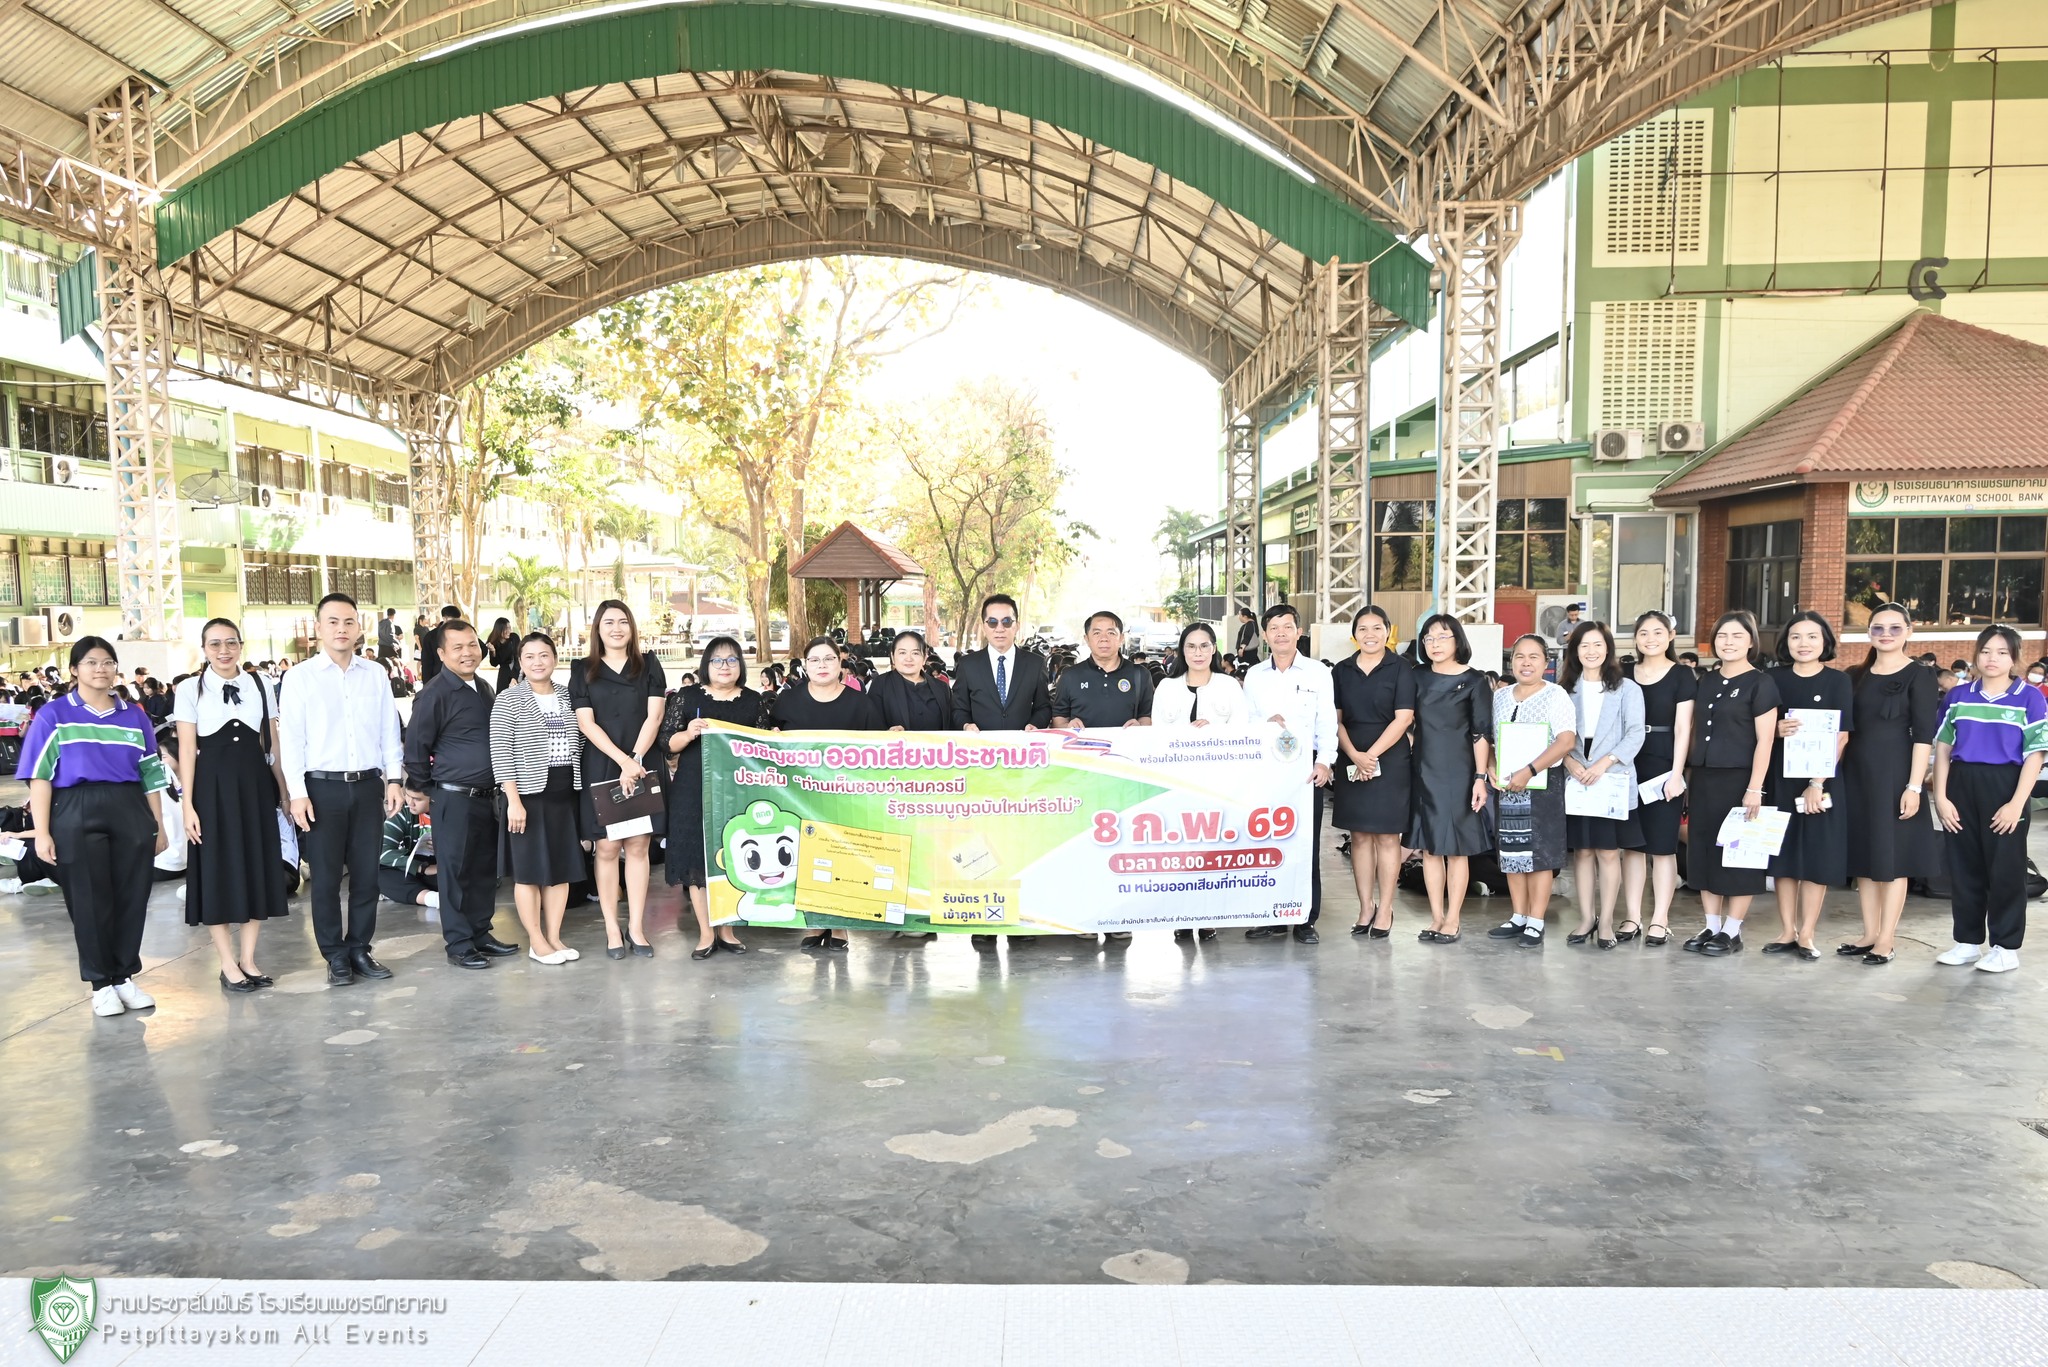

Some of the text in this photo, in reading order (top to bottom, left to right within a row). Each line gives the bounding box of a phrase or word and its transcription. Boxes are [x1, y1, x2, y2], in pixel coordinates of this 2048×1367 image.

[1893, 492, 2044, 504] PETPITTAYAKOM SCHOOL BANK
[1168, 736, 1261, 749] สร้างสรรค์ประเทศไทย
[731, 740, 1047, 767] ขอเชิญชวน ออกเสียงประชามติ
[1139, 750, 1263, 764] พร้อมใจไปออกเสียงประชามติ
[735, 767, 787, 785] ประเด็น
[1093, 806, 1296, 843] 8 ก.พ. 69
[1118, 857, 1157, 871] เวลา
[1258, 853, 1277, 865] น.
[1118, 871, 1277, 893] ณ หน่วยออกเสียงที่ท่านมีชื่อ
[943, 892, 1005, 904] รับบัตร 1 ใบ
[1273, 900, 1302, 910] สายด่วน
[943, 908, 982, 922] เข้าคูหา
[1278, 908, 1302, 918] 1444
